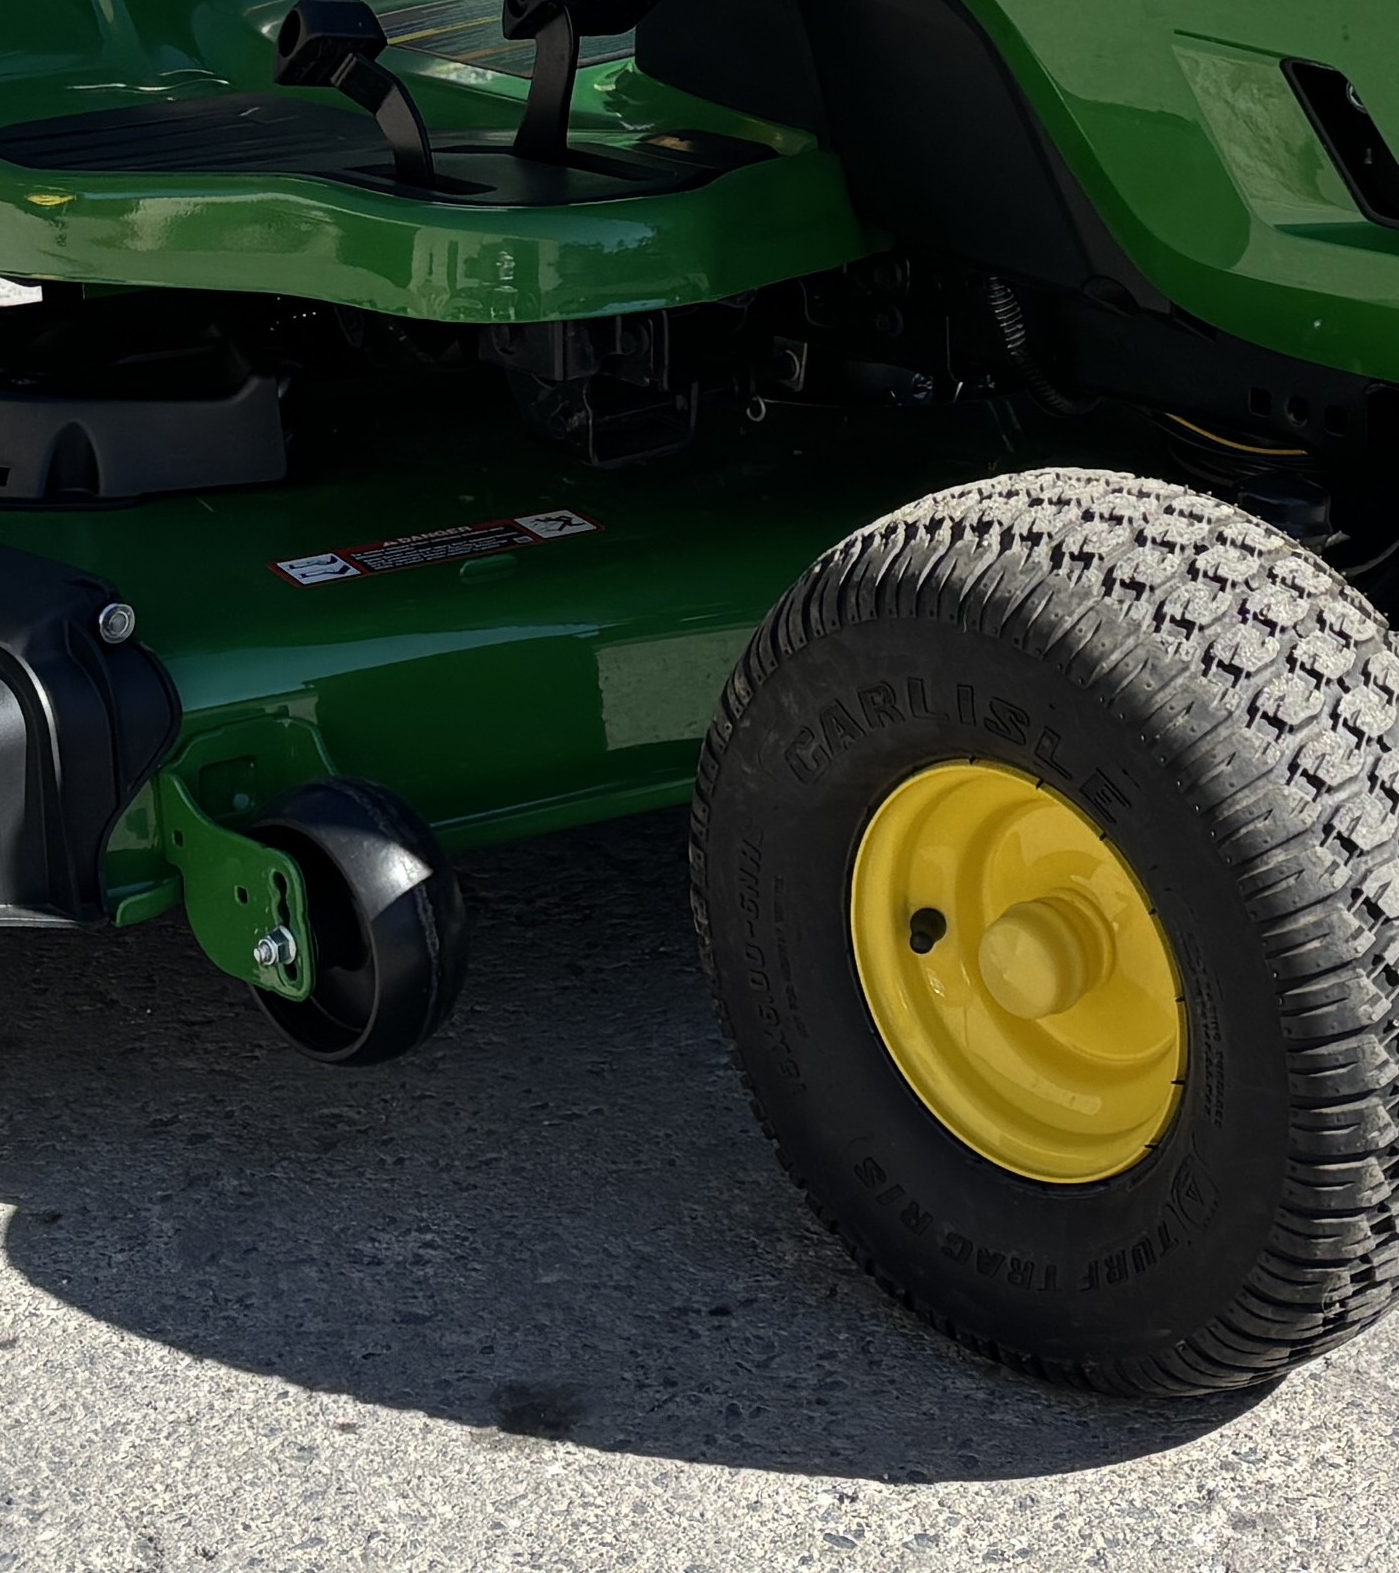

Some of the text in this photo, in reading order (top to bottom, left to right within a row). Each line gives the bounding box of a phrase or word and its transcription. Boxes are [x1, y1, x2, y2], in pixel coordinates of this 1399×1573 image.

[784, 677, 1133, 826] CARLISLE
[940, 1231, 1063, 1293] TRAC
[1078, 1221, 1180, 1293] TURF
